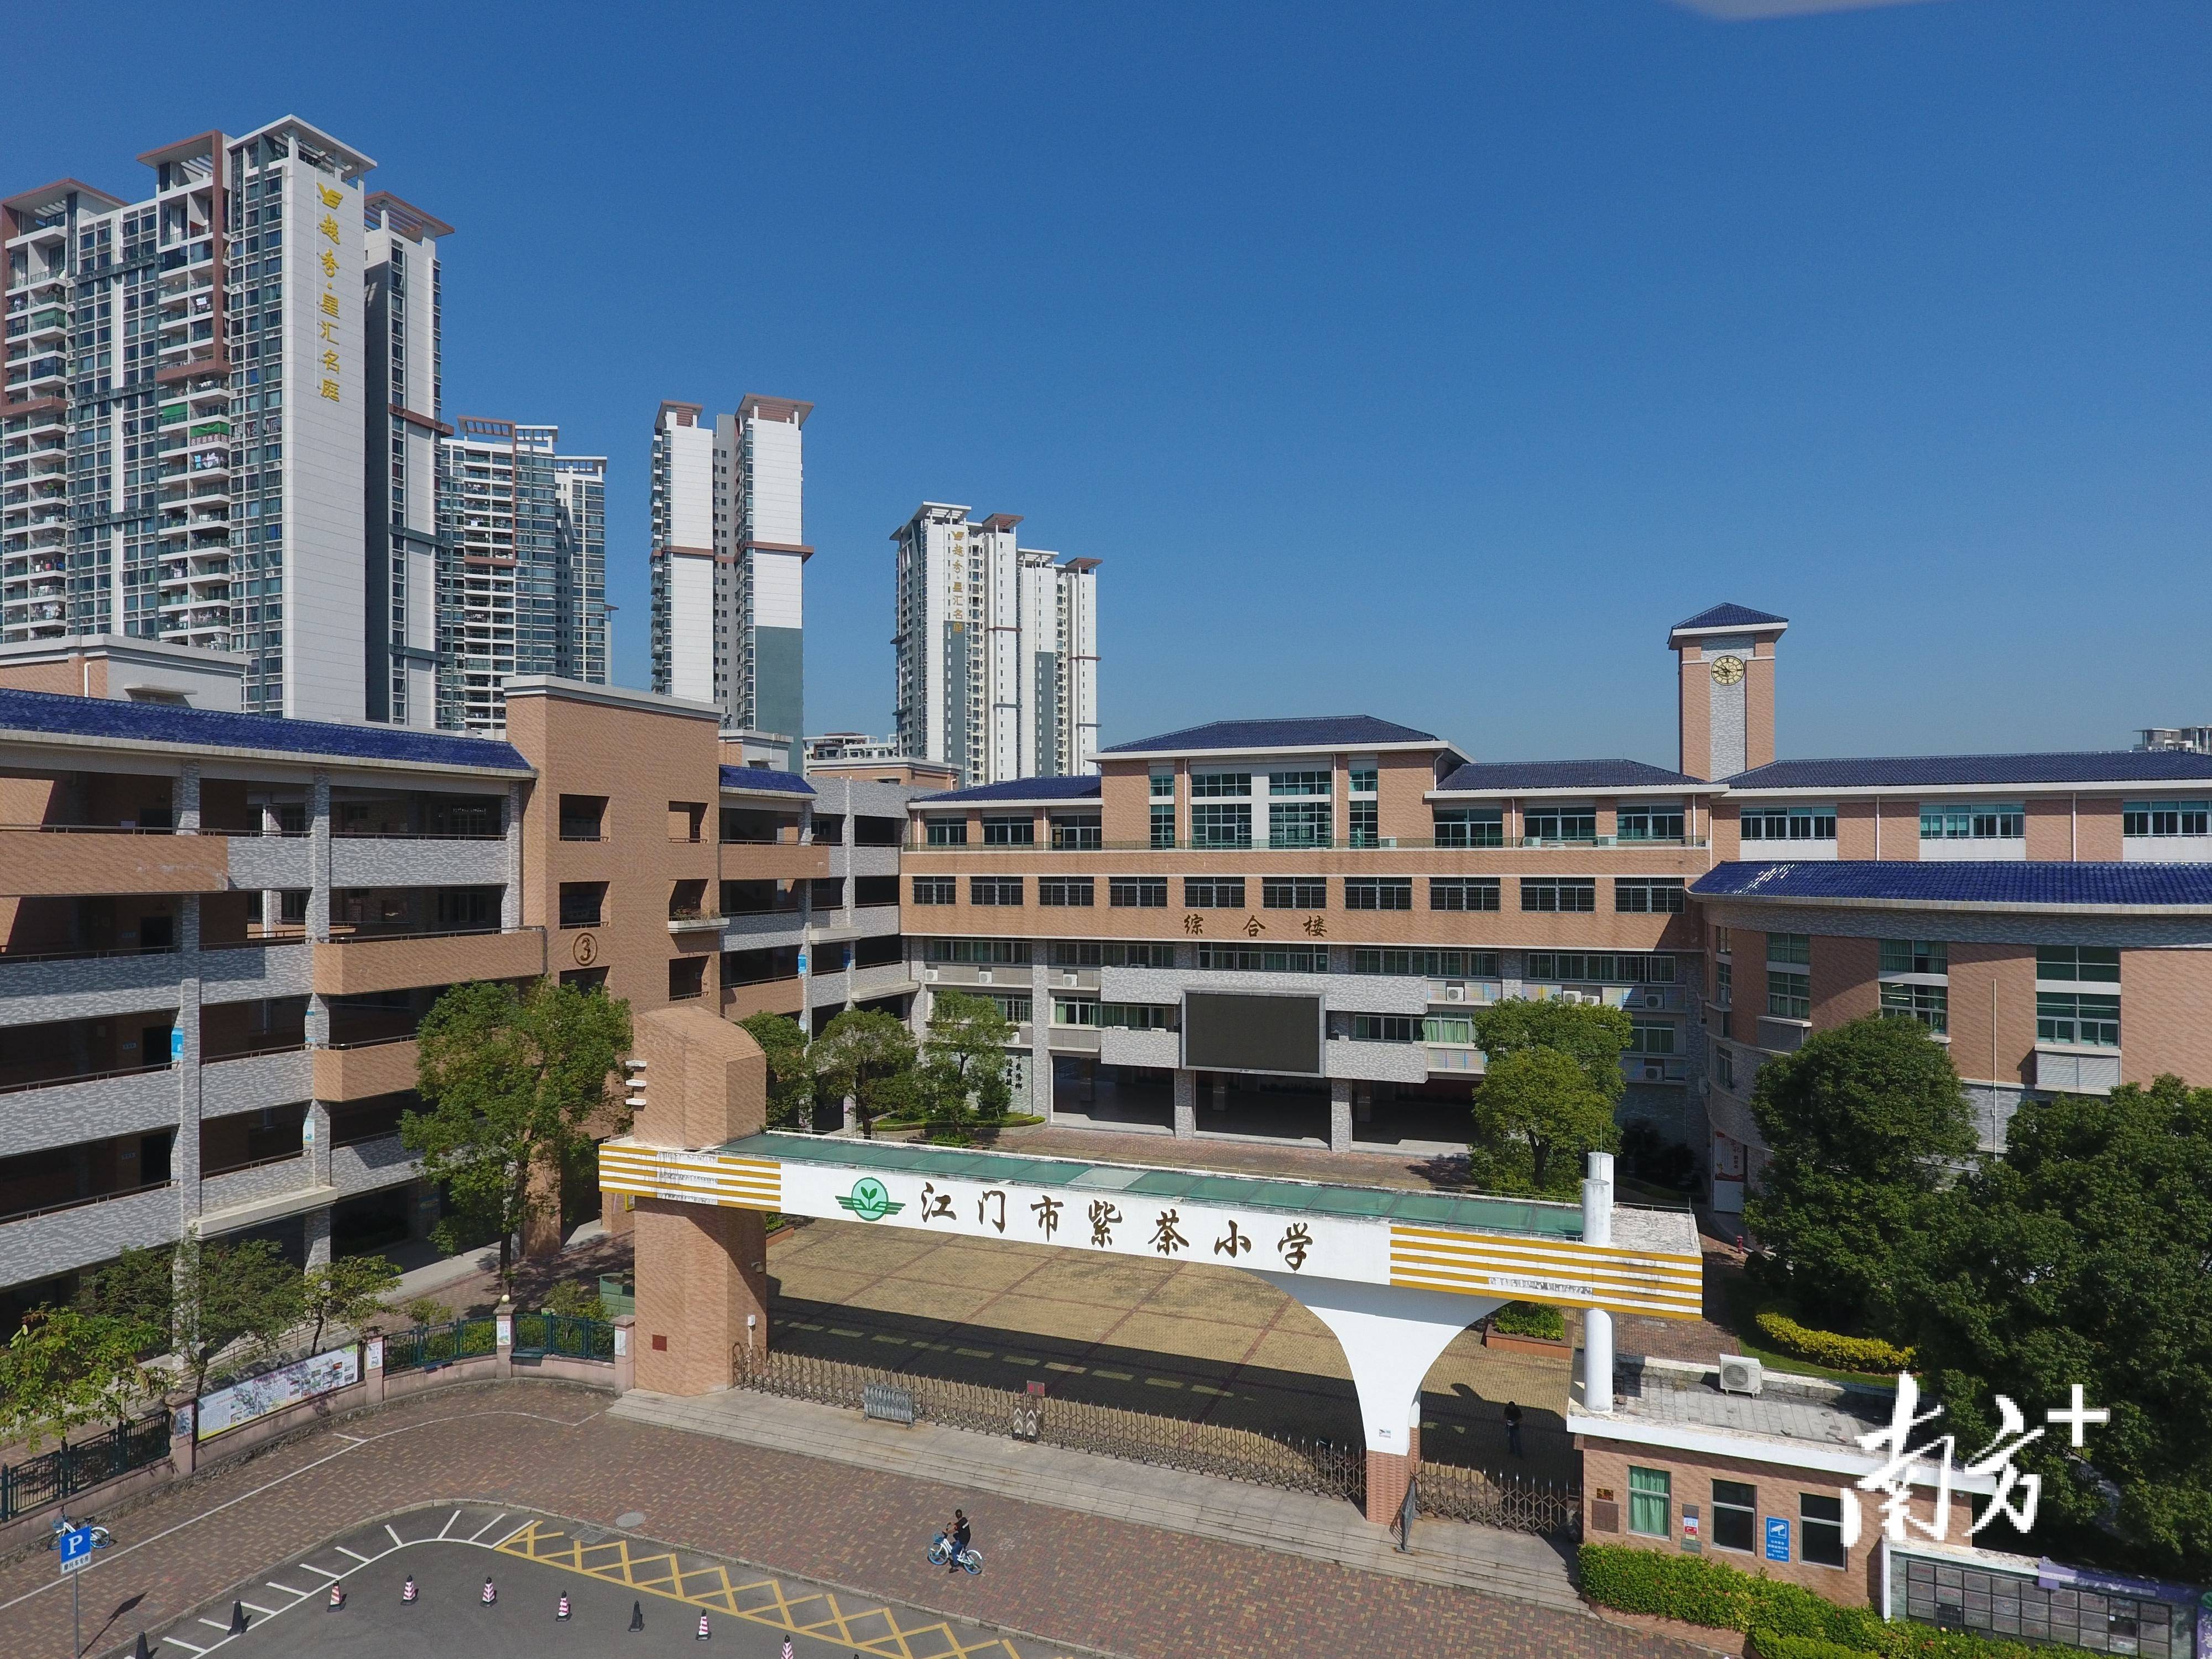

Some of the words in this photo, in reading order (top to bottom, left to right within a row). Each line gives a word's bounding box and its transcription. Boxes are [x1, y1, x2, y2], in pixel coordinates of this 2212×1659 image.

[1183, 914, 1328, 938] 综合楼
[921, 1182, 1314, 1271] 江门市紫茶小学
[68, 1535, 83, 1556] P
